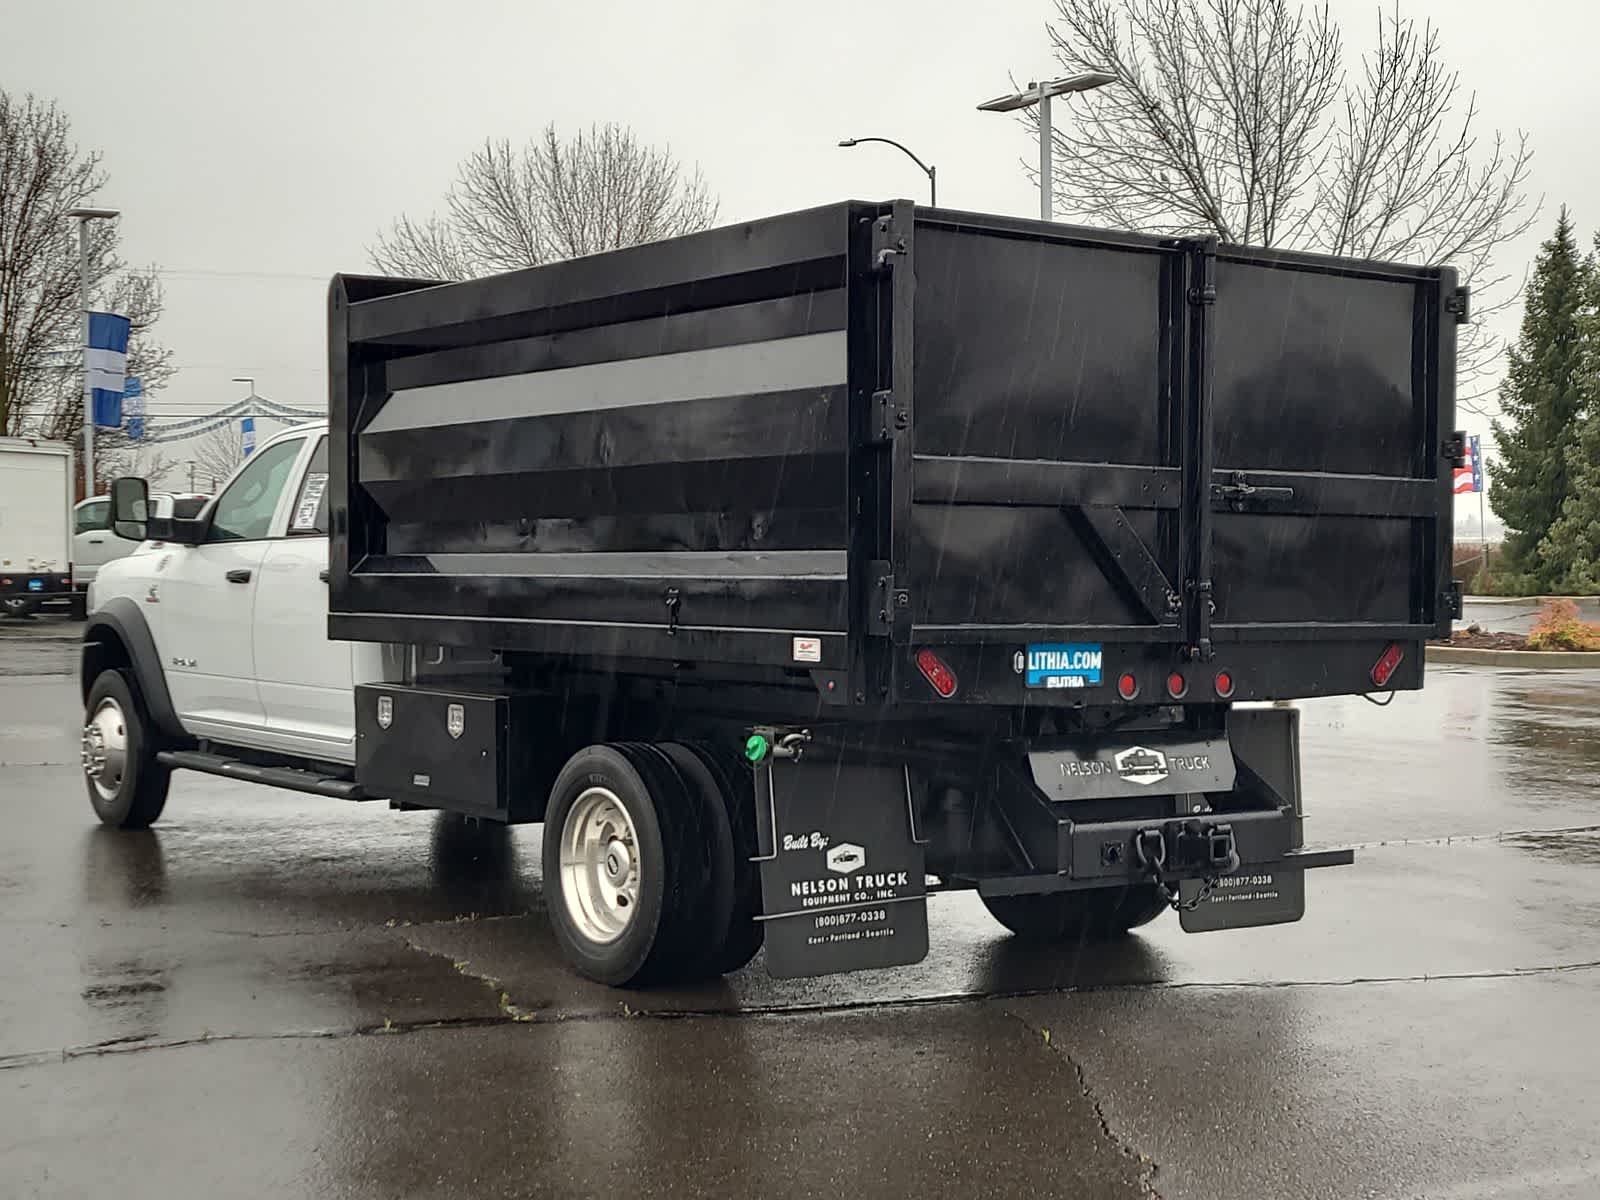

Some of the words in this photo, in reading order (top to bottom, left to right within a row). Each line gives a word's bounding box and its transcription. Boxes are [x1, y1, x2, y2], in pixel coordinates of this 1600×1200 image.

[1028, 651, 1102, 670] LITHIA.COM
[1056, 676, 1084, 688] LITHIA
[1061, 761, 1113, 777] NELSON
[1168, 755, 1210, 771] TRUCK
[783, 834, 808, 851] Built
[810, 831, 830, 850] By:
[791, 878, 849, 897] NELSON
[855, 871, 908, 888] TRUCK
[802, 894, 851, 907] EQUIPMENT
[854, 891, 874, 901] CO.,
[877, 889, 897, 898] INC.
[815, 910, 886, 929] (800)877-0338
